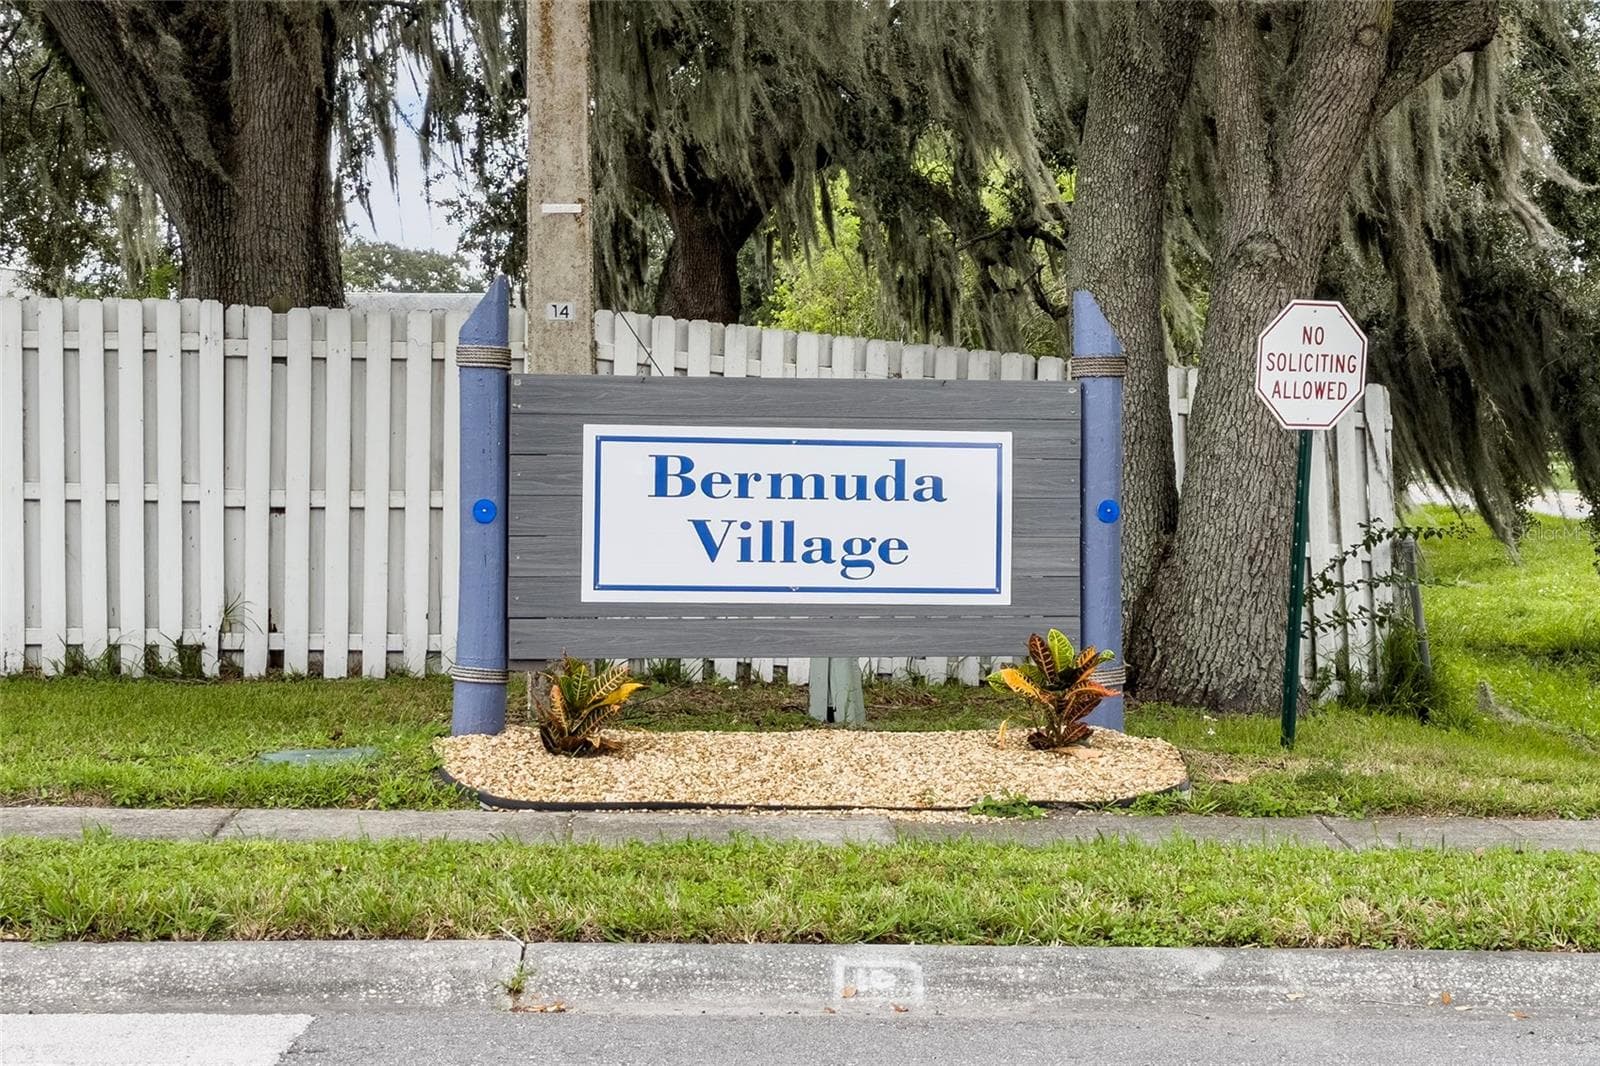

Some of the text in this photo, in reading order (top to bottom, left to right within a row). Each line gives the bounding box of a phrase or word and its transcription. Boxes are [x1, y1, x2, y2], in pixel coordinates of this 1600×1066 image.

[551, 304, 570, 319] 14
[1302, 326, 1325, 345] NO
[1266, 352, 1357, 374] SOLICITING
[1271, 380, 1348, 401] ALLOWED
[648, 454, 947, 503] Bermuda
[687, 519, 910, 580] Village
